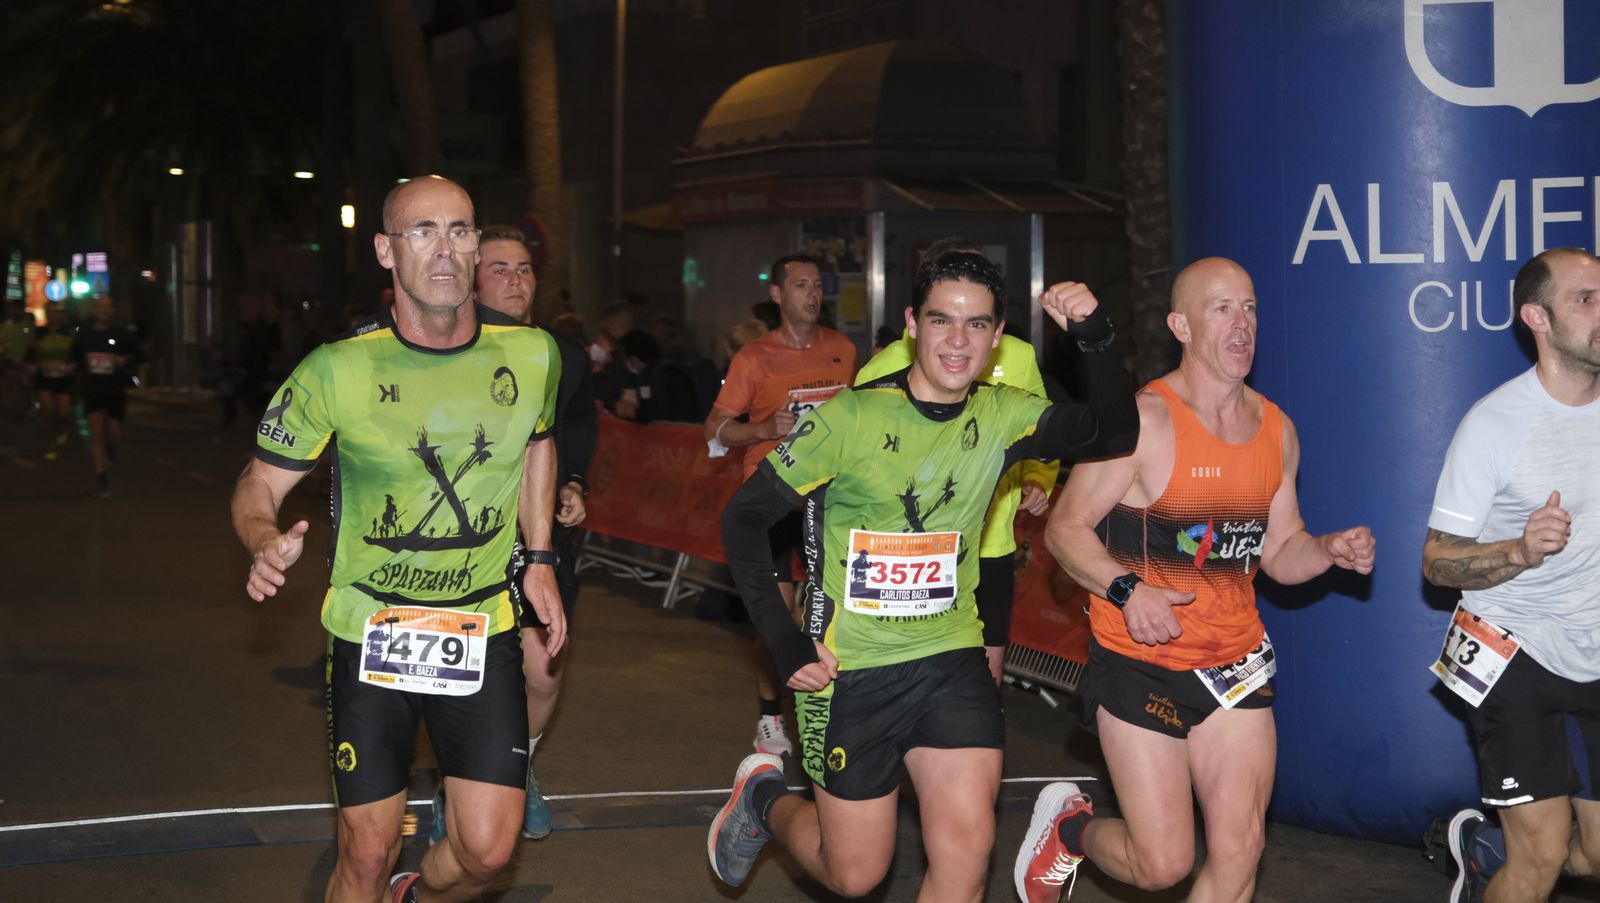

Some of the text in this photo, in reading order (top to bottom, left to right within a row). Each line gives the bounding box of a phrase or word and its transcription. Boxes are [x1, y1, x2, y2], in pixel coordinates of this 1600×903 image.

[1292, 176, 1600, 264] ALME
[1408, 279, 1515, 333] CIU
[1235, 532, 1266, 575] Ejid
[870, 561, 942, 585] 3572
[880, 589, 930, 600] CARLITOS BAEZA
[387, 631, 464, 666] 479
[408, 664, 438, 677] E. BAEZA
